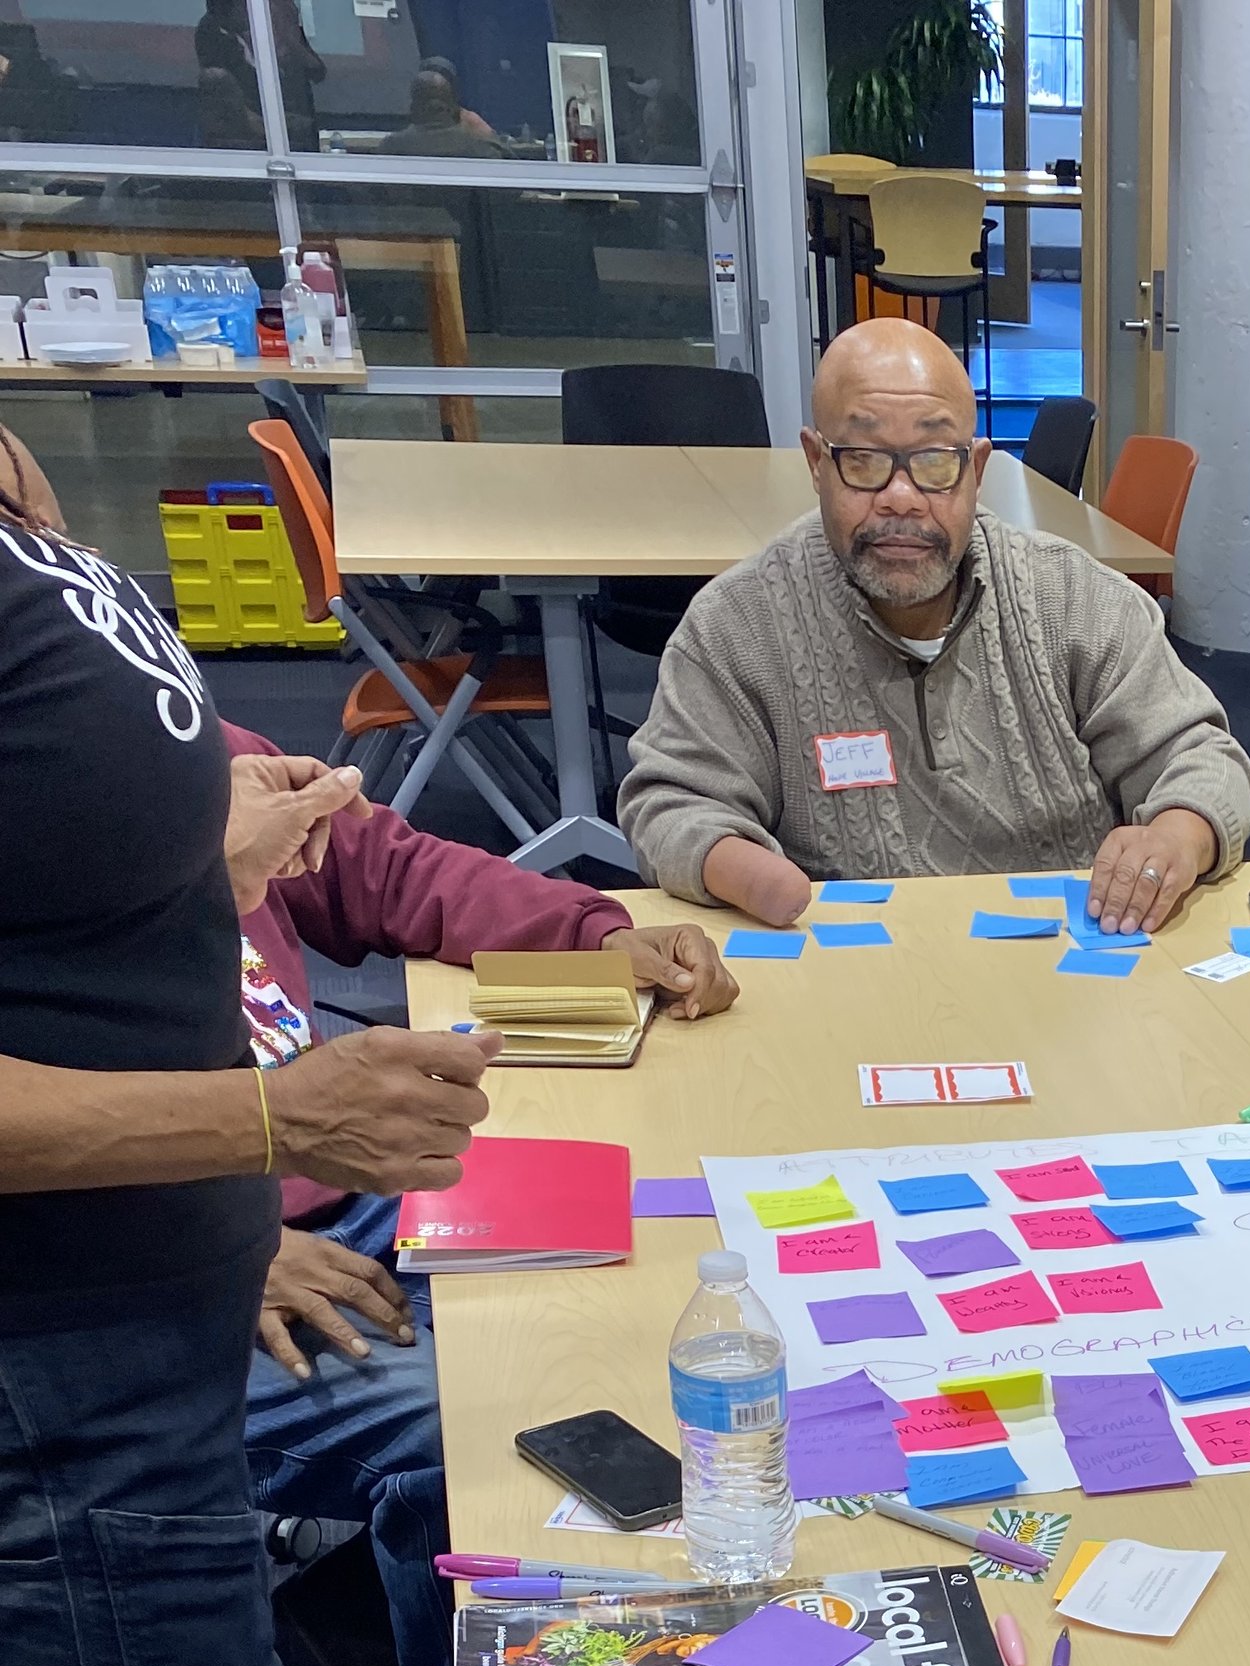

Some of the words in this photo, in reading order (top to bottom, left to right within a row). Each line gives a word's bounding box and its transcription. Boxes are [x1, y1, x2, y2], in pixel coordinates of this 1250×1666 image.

[822, 741, 874, 763] JEFF
[1022, 1218, 1038, 1226] I
[781, 1240, 795, 1248] I
[805, 1236, 838, 1245] am
[947, 1295, 966, 1305] I
[984, 1285, 1021, 1297] am
[921, 1406, 960, 1416] am
[1073, 1415, 1154, 1436] Female
[1201, 1421, 1226, 1434] I
[1230, 1448, 1249, 1459] I
[1106, 1451, 1164, 1475] LOVE
[874, 1576, 948, 1657] local
